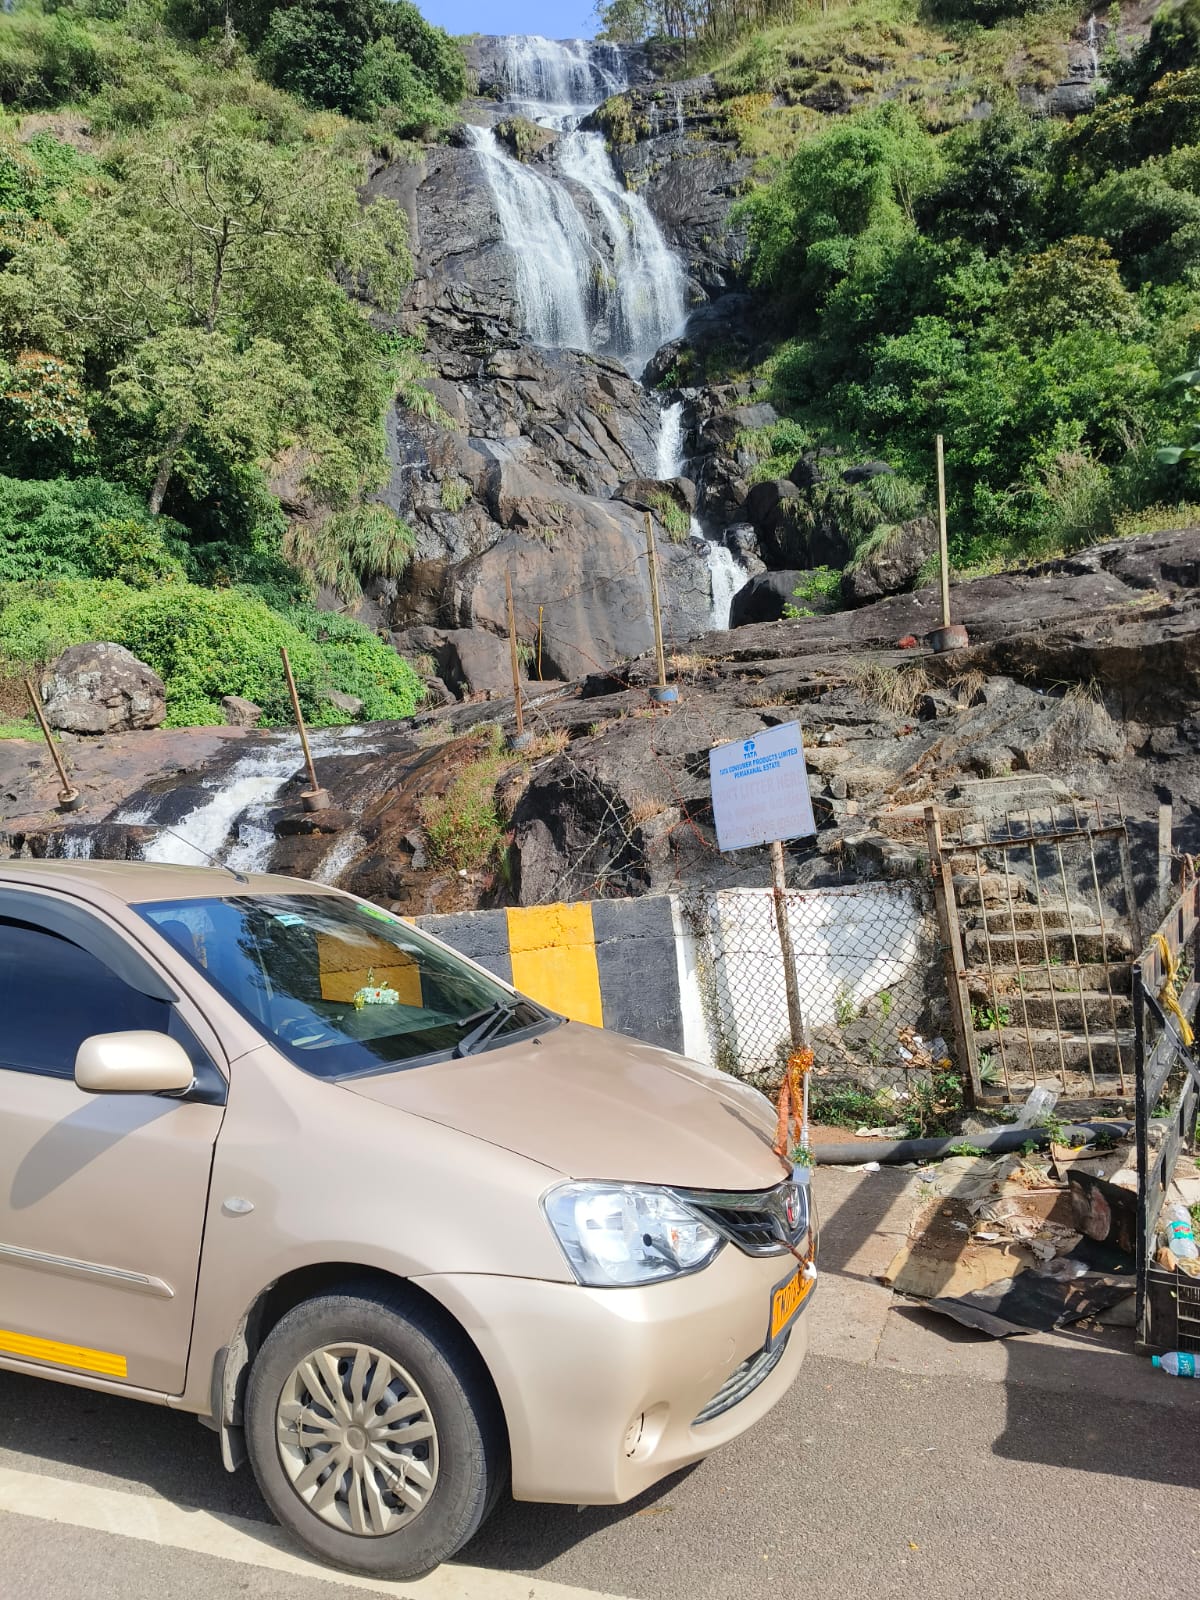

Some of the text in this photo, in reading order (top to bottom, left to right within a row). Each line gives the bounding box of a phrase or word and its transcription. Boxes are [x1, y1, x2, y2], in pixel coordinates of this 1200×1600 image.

[728, 760, 753, 774] CONSUMER
[752, 753, 778, 767] PRODUCTS
[778, 747, 798, 760] LIMITED
[743, 751, 758, 760] TATA
[763, 761, 781, 772] ESTATE
